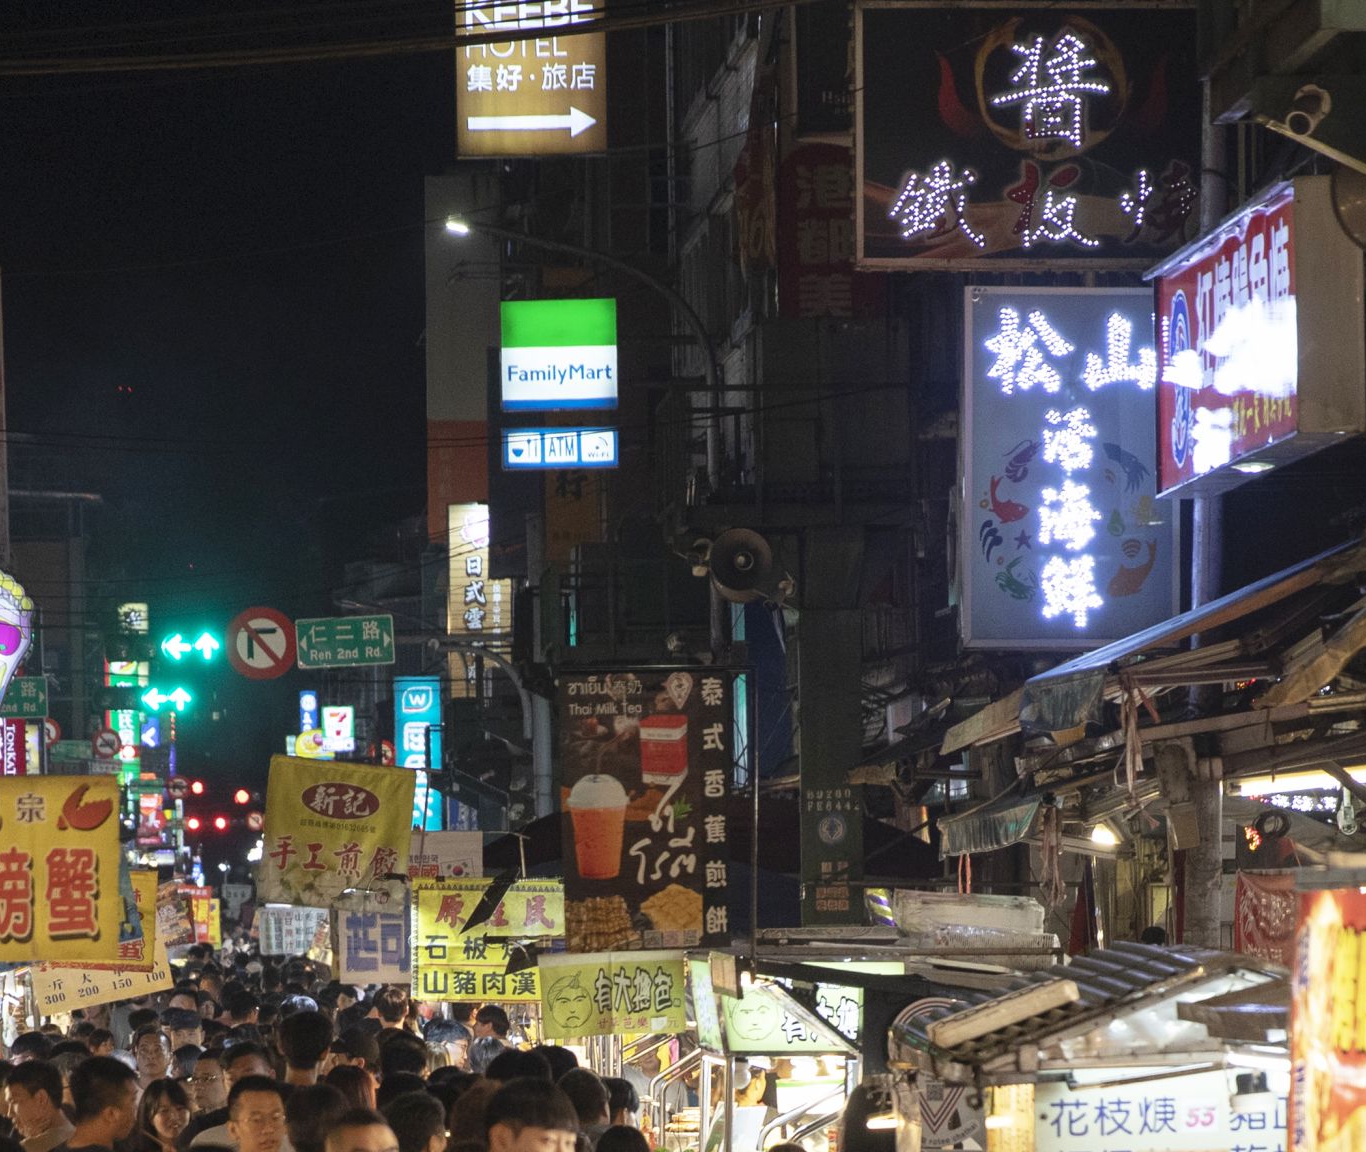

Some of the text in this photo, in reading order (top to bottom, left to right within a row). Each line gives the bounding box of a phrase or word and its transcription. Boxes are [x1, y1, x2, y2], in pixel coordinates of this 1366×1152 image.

[992, 33, 1111, 147] 醬
[985, 306, 1159, 396] 松山
[507, 363, 613, 385] FamilyMart
[548, 436, 575, 457] ATM
[1039, 406, 1103, 629] 活海鮮
[309, 621, 382, 643] 仁二路
[310, 649, 332, 661] Ren
[337, 648, 359, 659] 2nd
[568, 701, 643, 716] Thai Milk Tea
[16, 794, 47, 825] 宗
[309, 785, 371, 816] 新記
[701, 676, 729, 935] 泰式香蕉煎餅
[268, 834, 399, 880] 手工煎餃
[112, 977, 133, 990] 150
[145, 970, 166, 984] 100
[423, 970, 537, 996] 山豬肉漢
[45, 992, 66, 1005] 300
[78, 984, 100, 998] 200
[1184, 1105, 1217, 1128] 55
